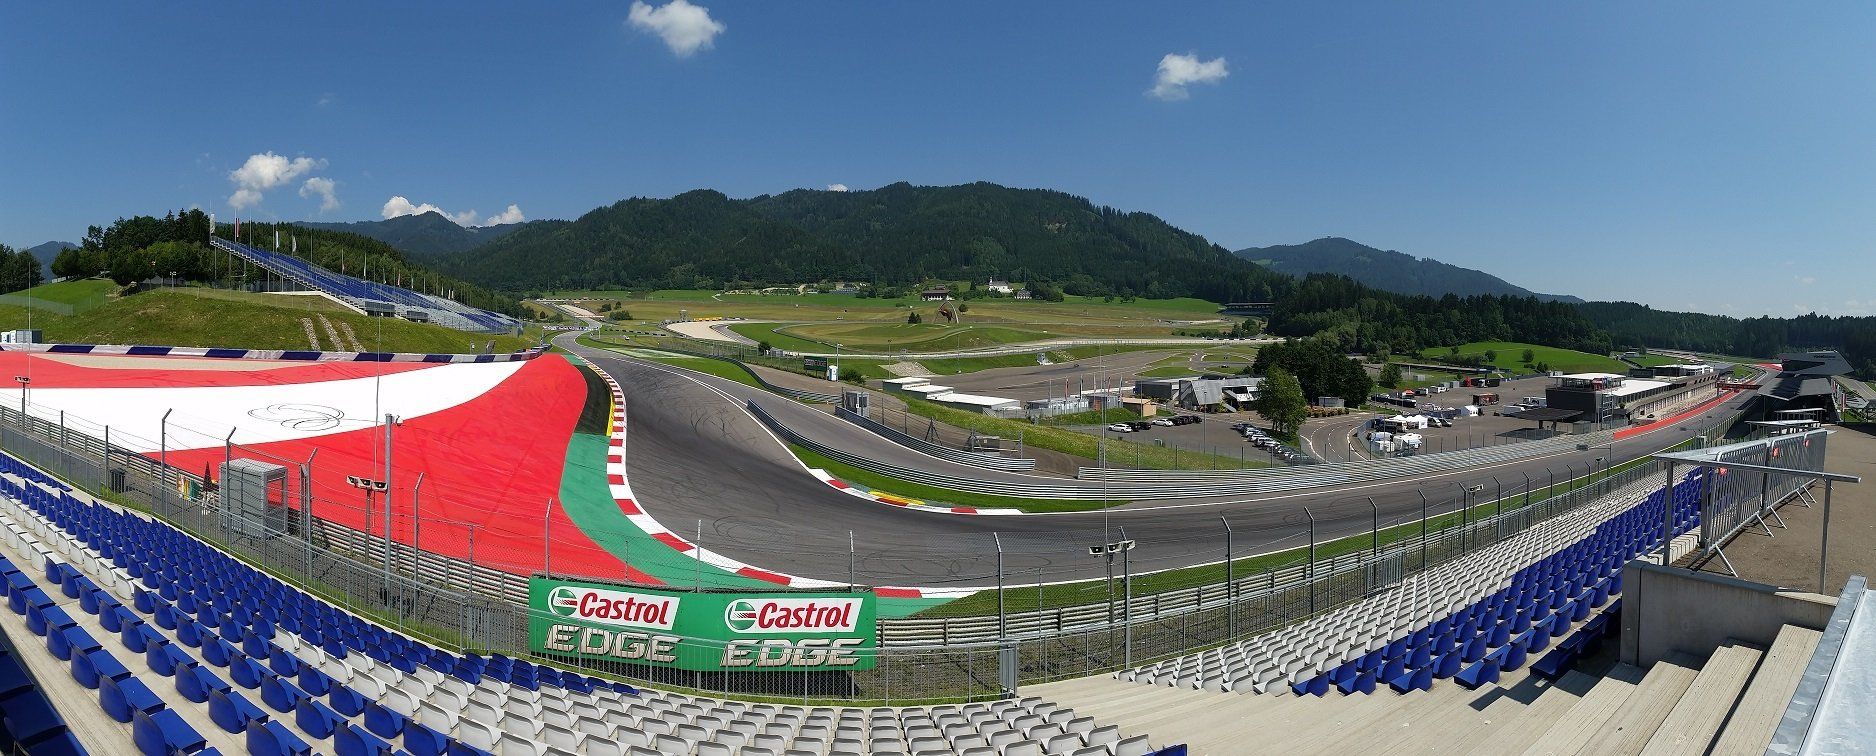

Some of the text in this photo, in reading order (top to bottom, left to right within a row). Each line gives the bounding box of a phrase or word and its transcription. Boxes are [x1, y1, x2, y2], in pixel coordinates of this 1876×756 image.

[579, 592, 669, 625] Castrol
[758, 602, 852, 629] Castrol
[544, 624, 683, 663] EDGE
[719, 638, 867, 668] EDGE
